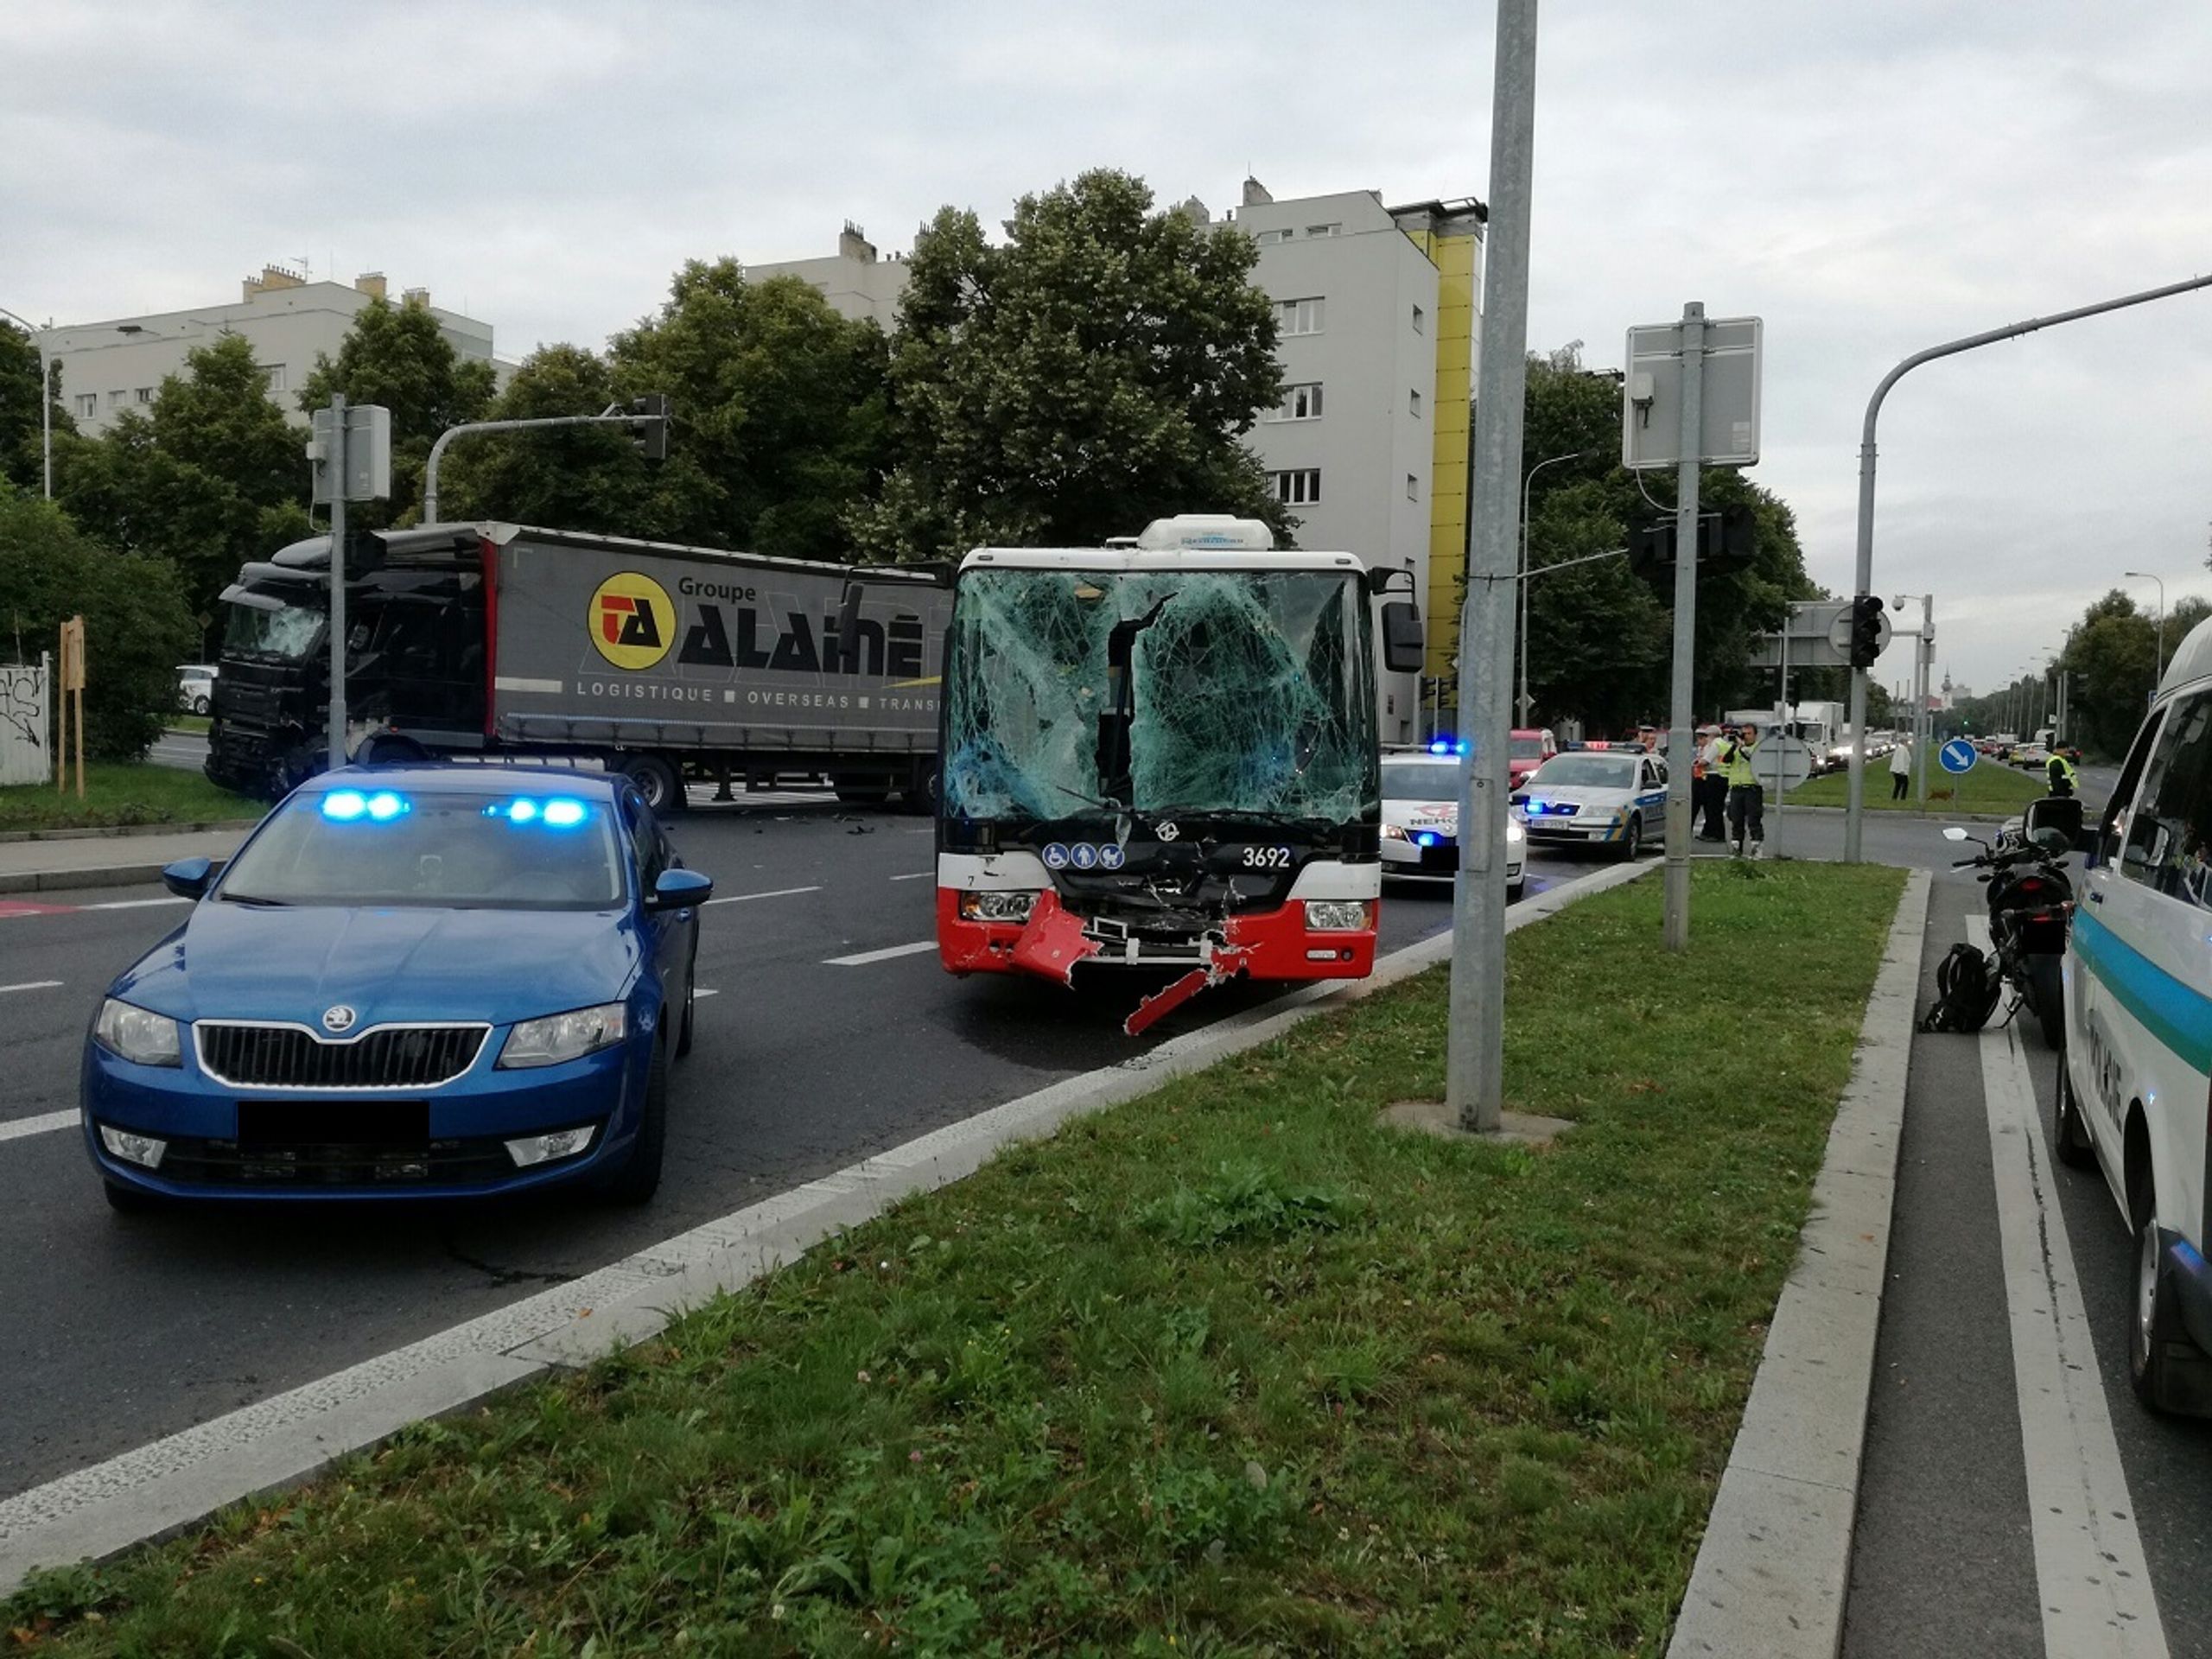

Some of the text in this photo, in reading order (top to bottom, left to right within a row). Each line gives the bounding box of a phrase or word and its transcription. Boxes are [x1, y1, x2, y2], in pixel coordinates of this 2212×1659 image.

[678, 576, 756, 604] Groupe
[576, 681, 712, 702] LOGISTIQUE
[747, 691, 849, 709] OVERSEAS
[1243, 847, 1290, 868] 3692
